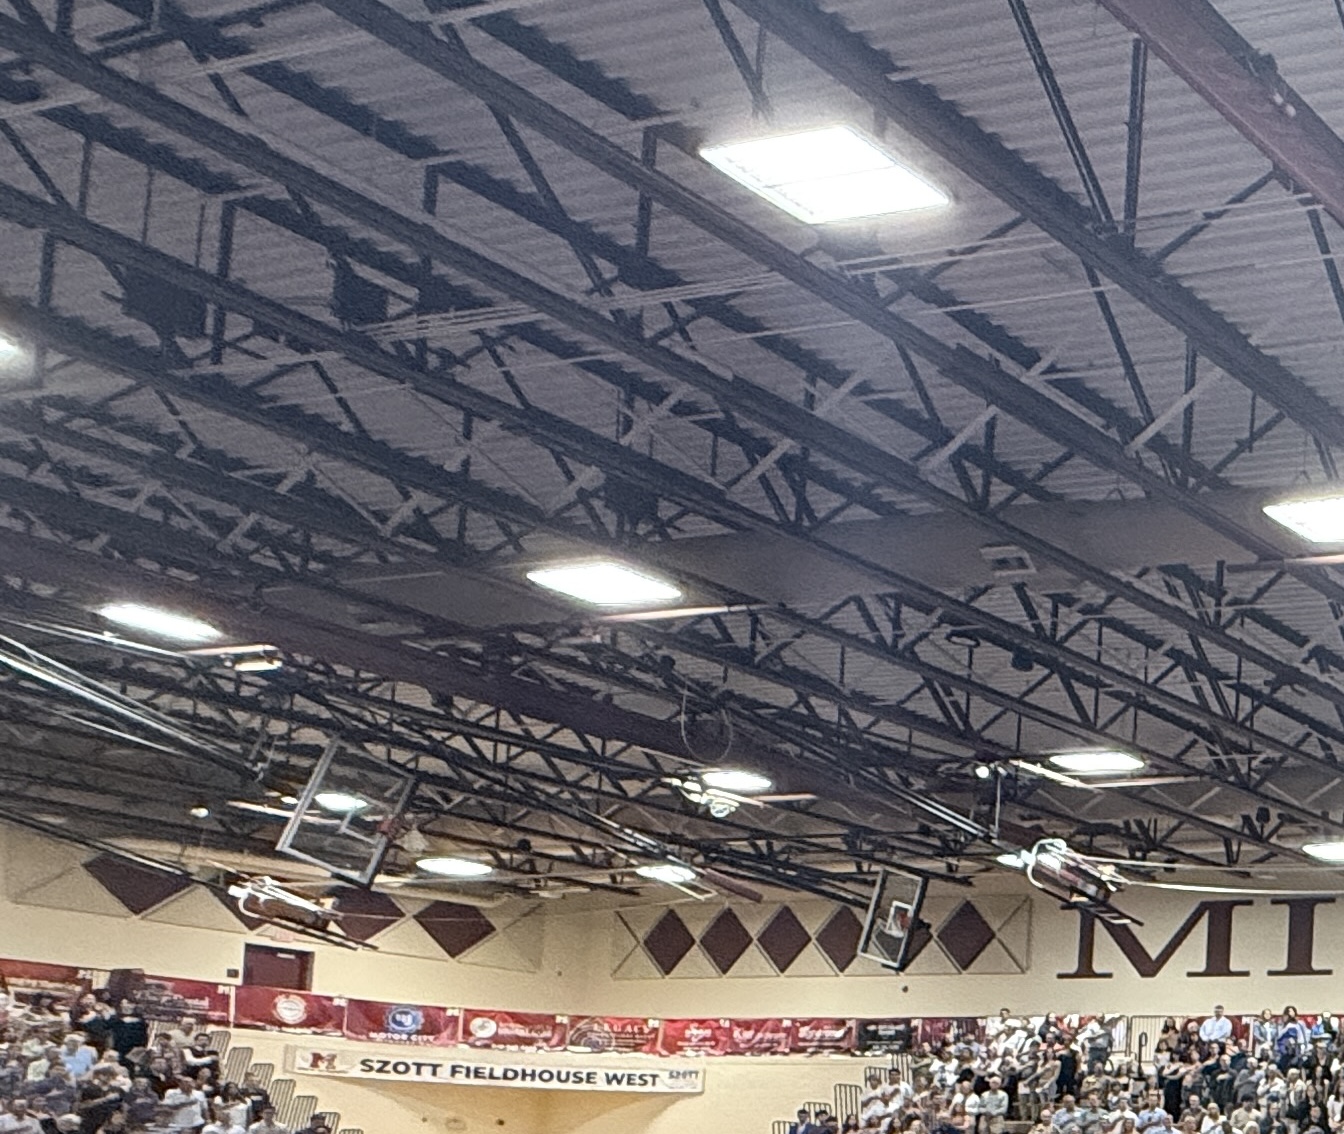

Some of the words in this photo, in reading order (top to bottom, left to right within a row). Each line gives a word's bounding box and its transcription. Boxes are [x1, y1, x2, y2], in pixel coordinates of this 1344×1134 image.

[310, 1052, 337, 1069] M
[360, 1058, 443, 1077] SZOTT
[450, 1064, 597, 1084] FIELDHOUSE
[604, 1072, 660, 1087] WEST
